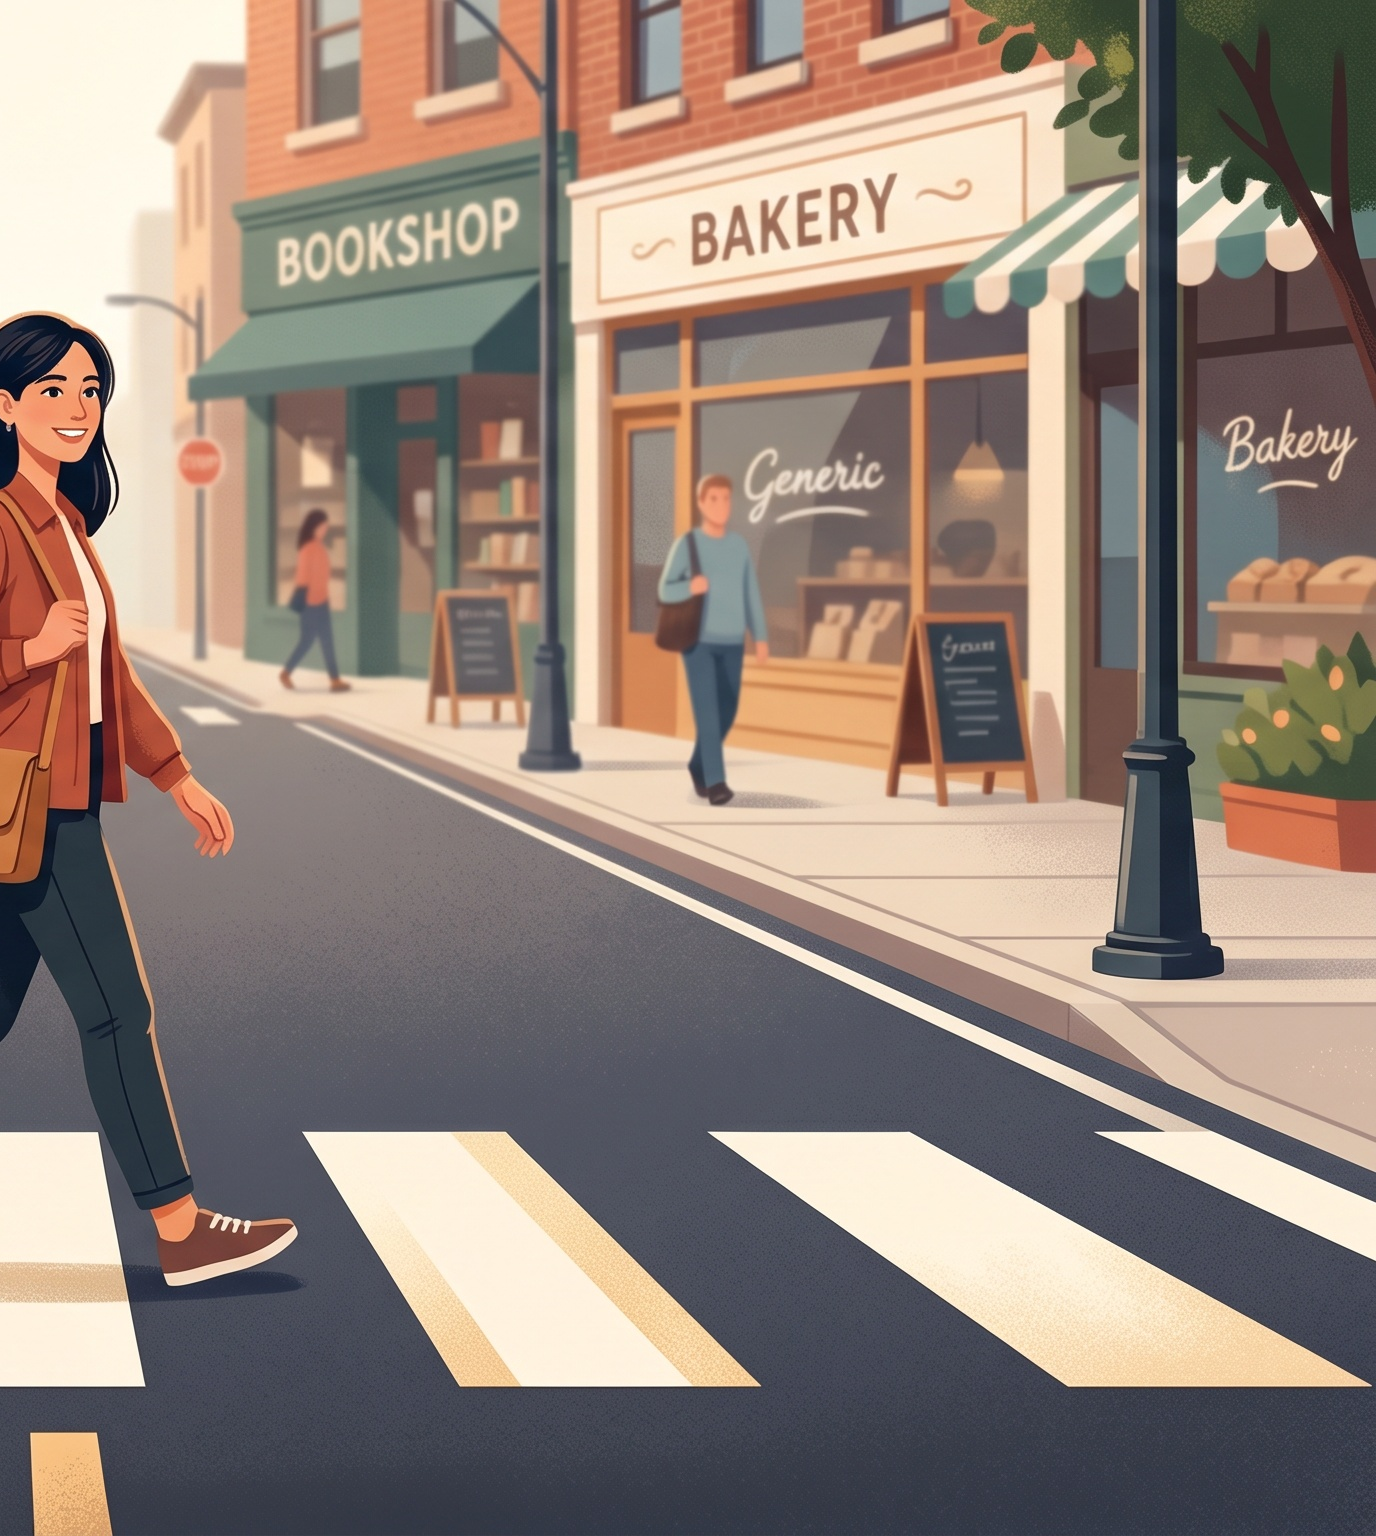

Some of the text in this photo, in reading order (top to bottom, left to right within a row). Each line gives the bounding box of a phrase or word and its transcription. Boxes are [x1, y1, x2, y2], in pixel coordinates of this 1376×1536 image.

[278, 197, 520, 287] BOOKSHOP
[691, 173, 898, 266] BAKERY
[743, 447, 885, 524] Generic
[1222, 407, 1358, 481] Bakery
